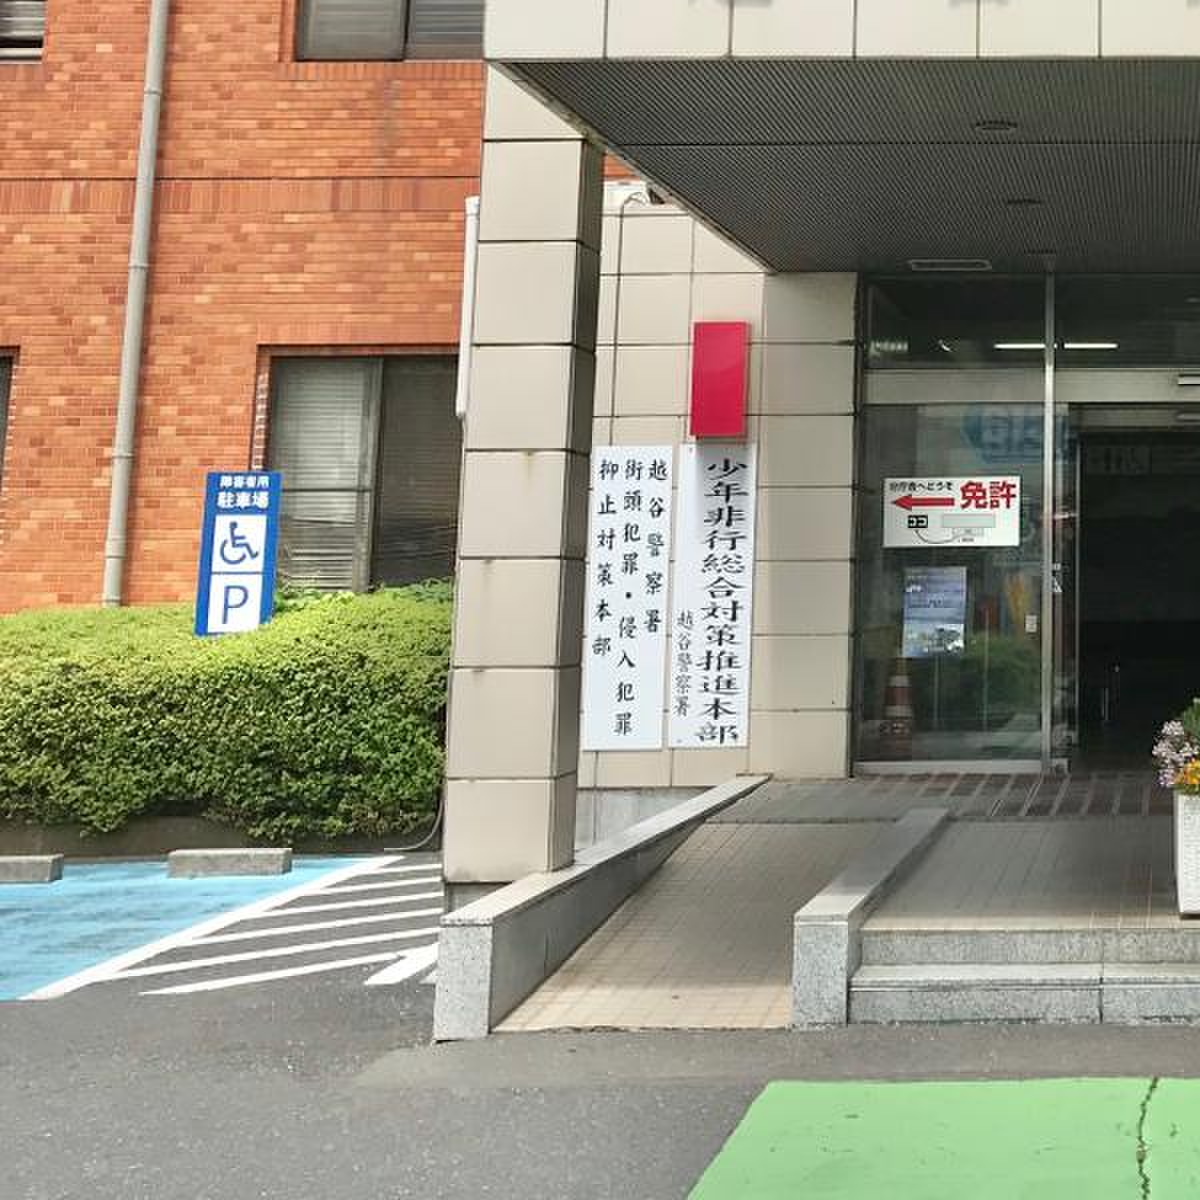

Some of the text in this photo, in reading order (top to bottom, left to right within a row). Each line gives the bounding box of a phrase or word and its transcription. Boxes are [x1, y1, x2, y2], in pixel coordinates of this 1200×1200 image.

[217, 491, 270, 510] 駐車場
[592, 458, 619, 657] 抑止対策本部
[644, 458, 667, 633] 越谷警察署
[960, 480, 1017, 510] 免許
[222, 584, 249, 625] P
[613, 458, 643, 736] 街頭犯罪・侵入犯罪
[695, 457, 749, 744] 少年非行総合対策推進本部
